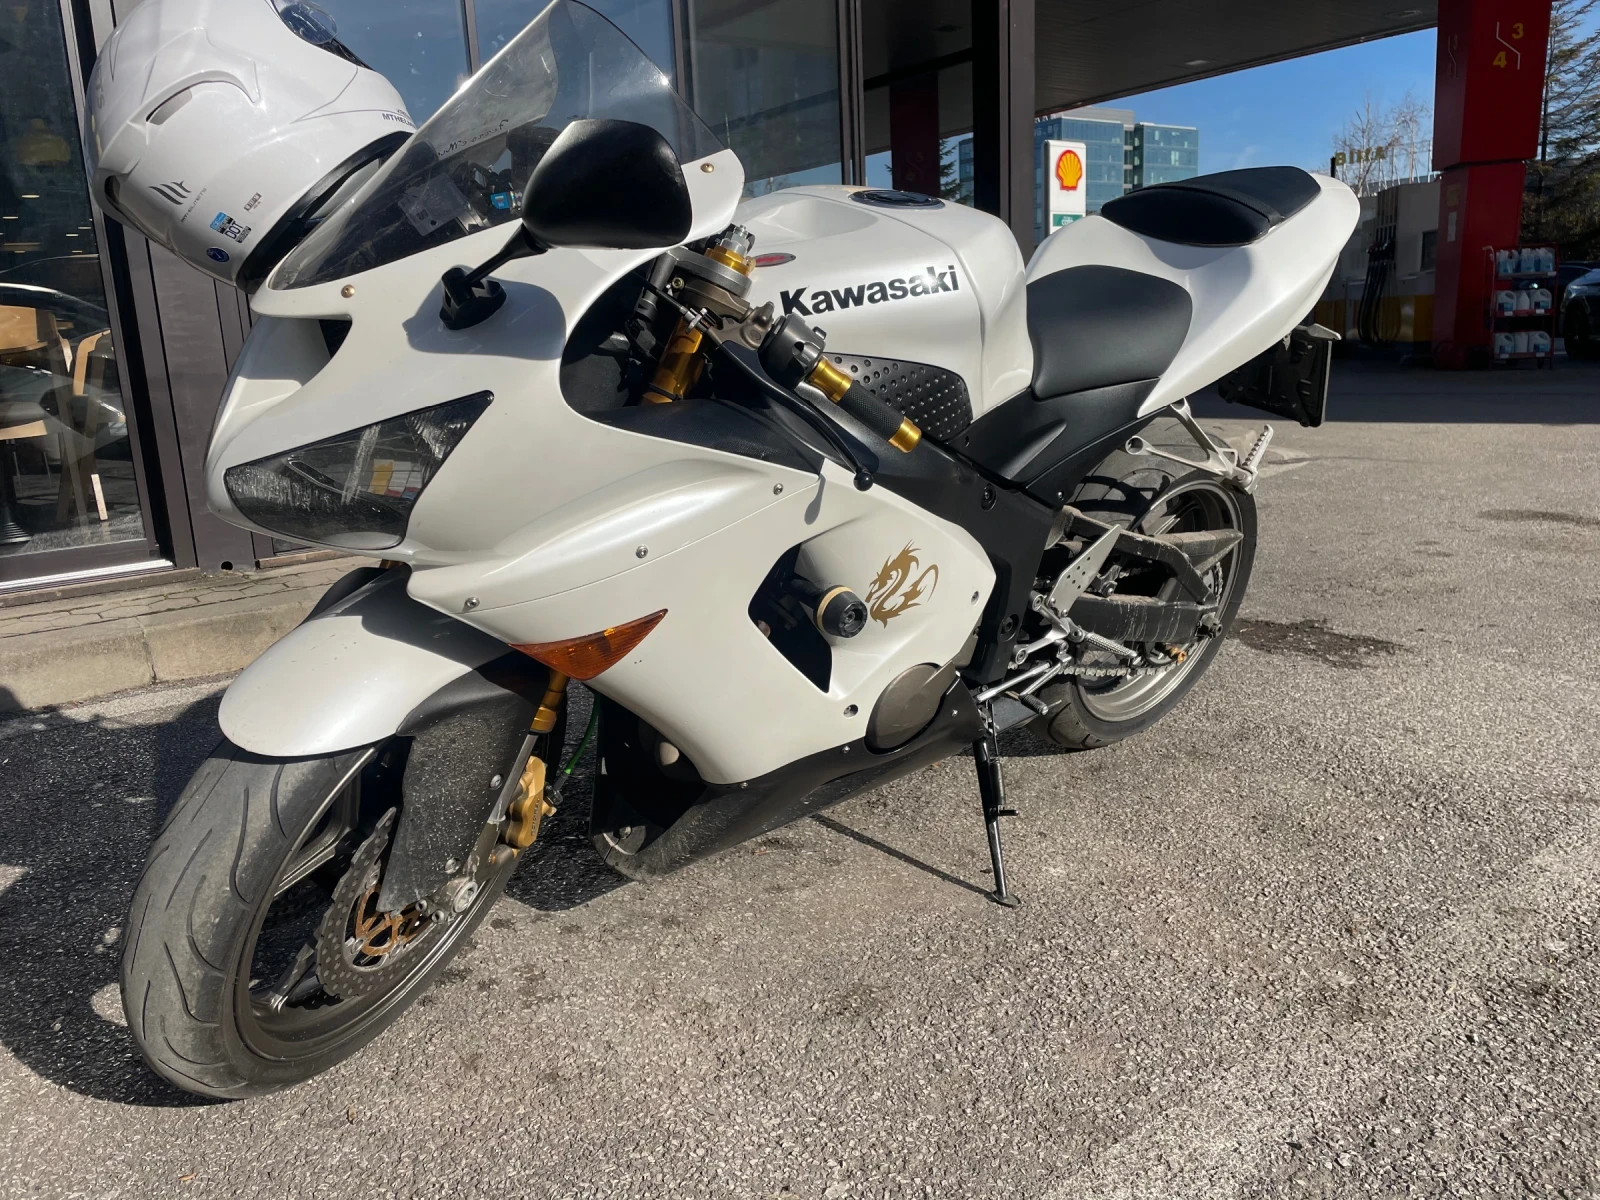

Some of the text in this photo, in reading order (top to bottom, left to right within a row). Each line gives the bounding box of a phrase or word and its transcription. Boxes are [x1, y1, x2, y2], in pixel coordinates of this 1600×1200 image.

[1511, 22, 1524, 39] 3
[1492, 51, 1507, 68] 4
[224, 221, 243, 240] DOT
[779, 265, 959, 316] Kawasaki
